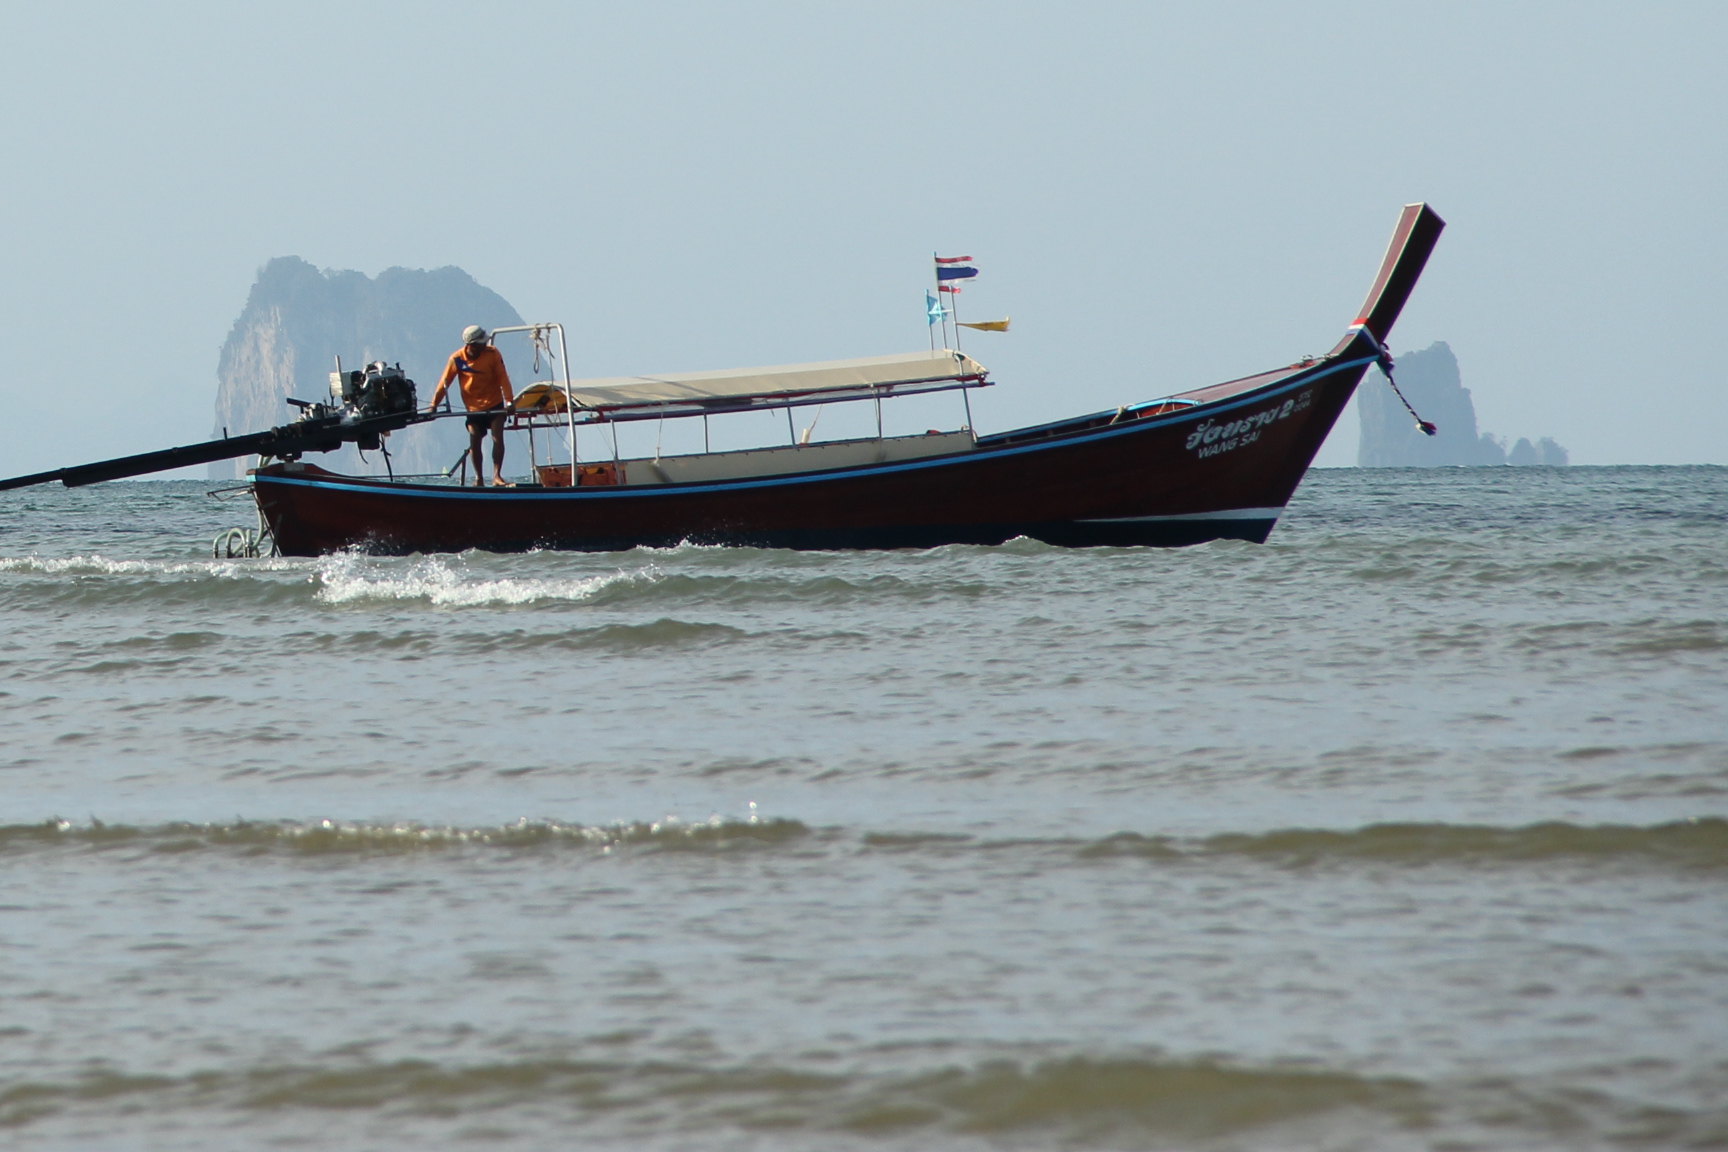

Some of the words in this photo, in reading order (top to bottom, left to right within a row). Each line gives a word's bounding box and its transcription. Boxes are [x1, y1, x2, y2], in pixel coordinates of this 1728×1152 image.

[1278, 399, 1294, 419] 2
[1198, 438, 1238, 459] WANG
[1240, 430, 1261, 446] SAI
